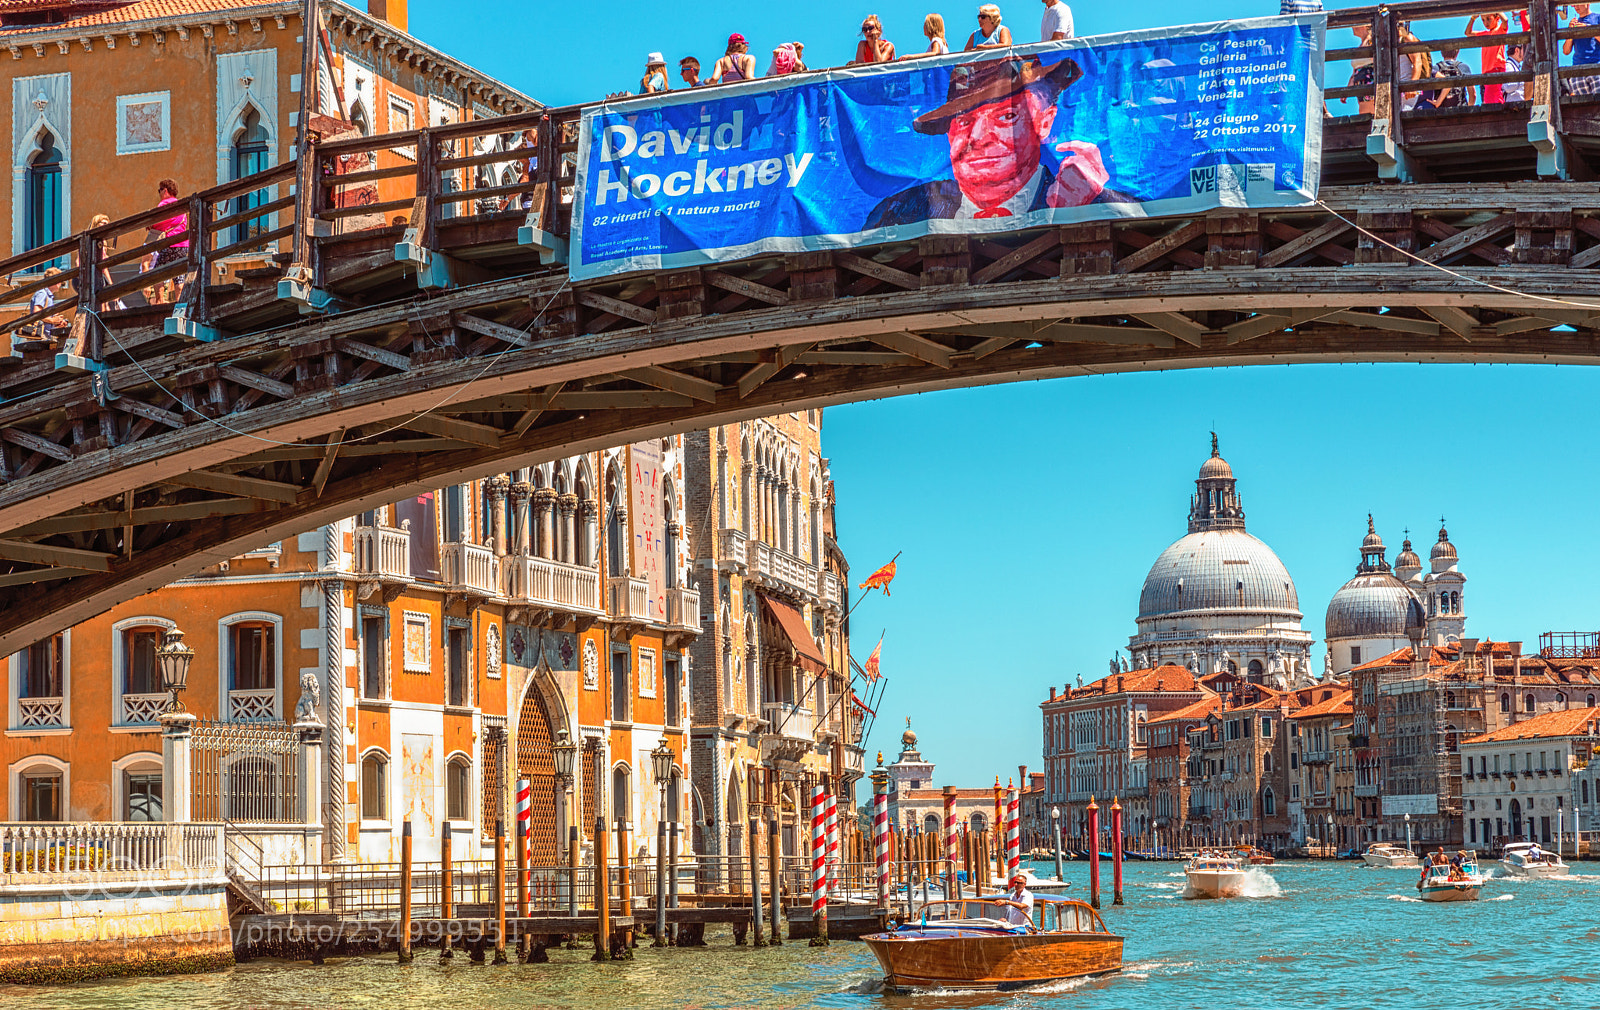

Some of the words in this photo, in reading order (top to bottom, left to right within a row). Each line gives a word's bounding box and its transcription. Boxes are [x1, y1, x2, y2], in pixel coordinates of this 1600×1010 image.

[1223, 38, 1266, 50] Pesaro
[1199, 53, 1247, 66] Galleria
[1198, 61, 1287, 79] Internazionale
[1240, 73, 1296, 85] Moderna
[1197, 89, 1244, 103] Venezia
[1194, 118, 1210, 128] 24
[1213, 113, 1259, 125] Giugno
[600, 110, 744, 163] David
[1193, 129, 1208, 140] 22
[1211, 125, 1260, 137] Ottobre
[1263, 123, 1297, 134] 2017
[595, 152, 814, 206] Hockney
[1191, 167, 1215, 182] MU
[1193, 179, 1214, 193] VE
[592, 214, 608, 227] 82
[610, 207, 651, 224] ritratti
[666, 207, 673, 216] 1
[676, 204, 720, 216] natura
[723, 199, 760, 213] morta
